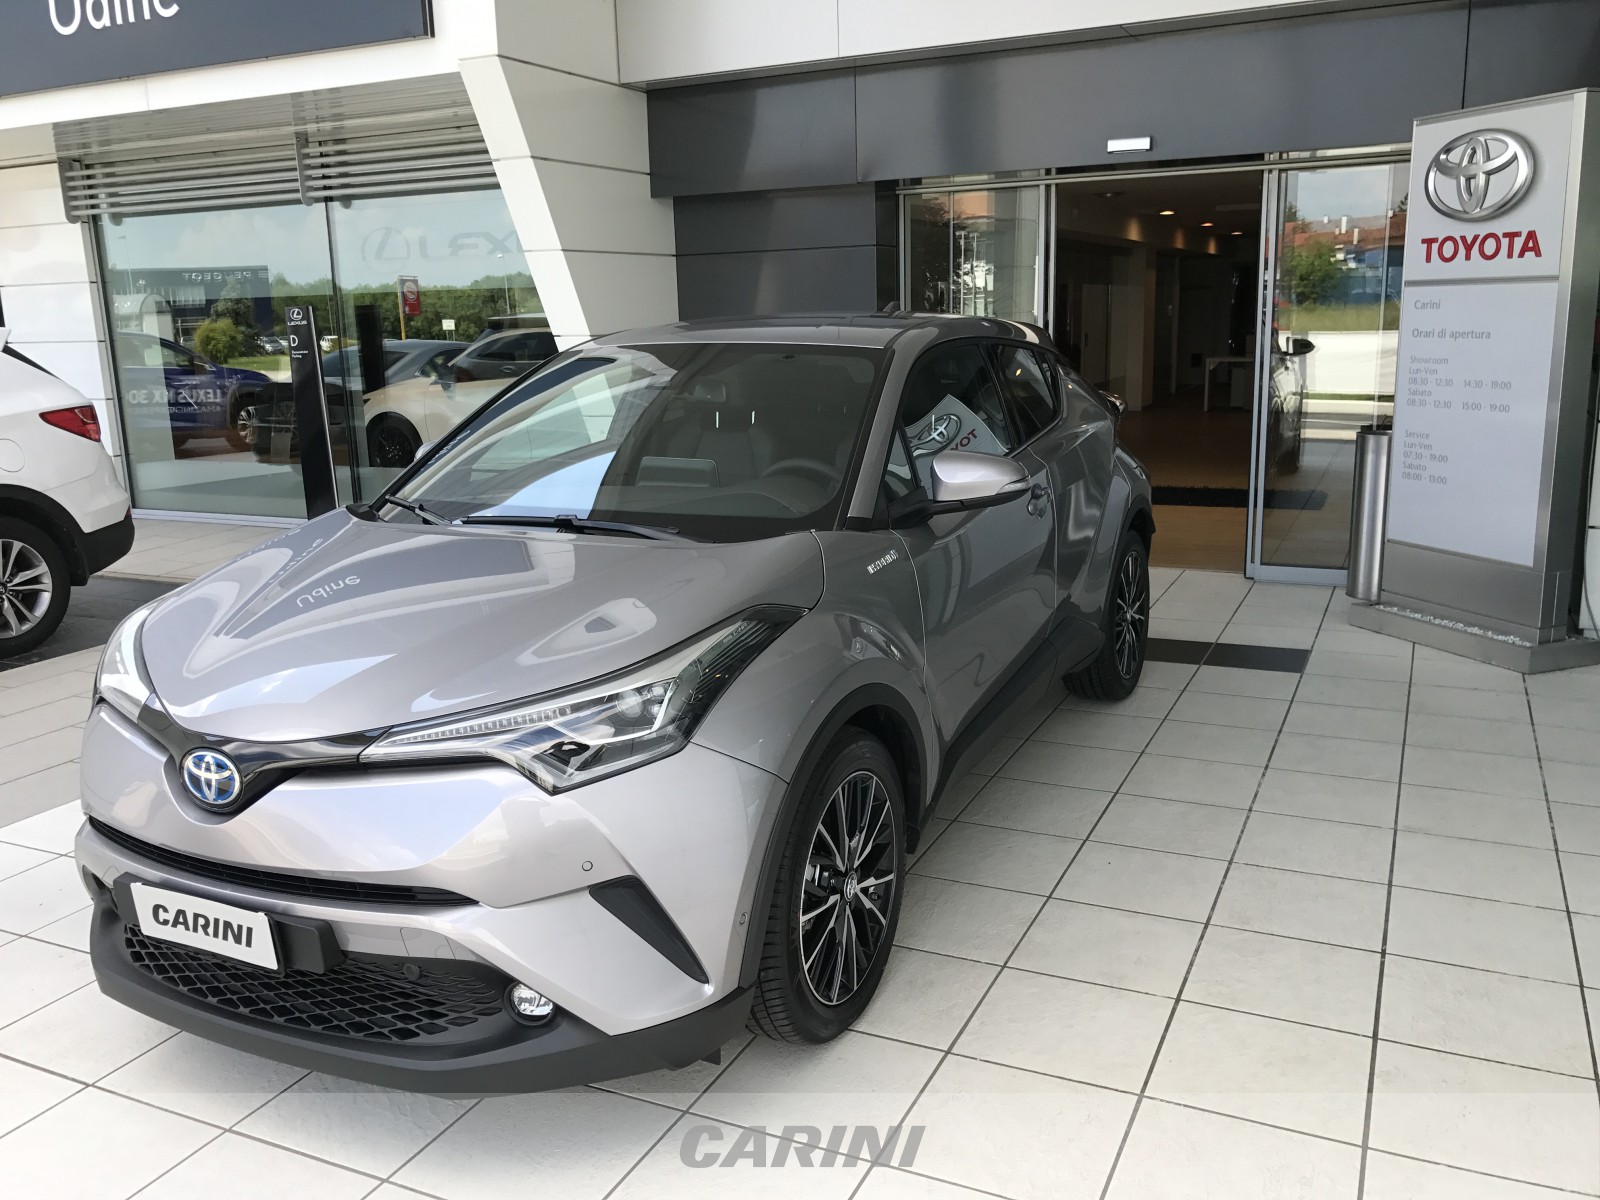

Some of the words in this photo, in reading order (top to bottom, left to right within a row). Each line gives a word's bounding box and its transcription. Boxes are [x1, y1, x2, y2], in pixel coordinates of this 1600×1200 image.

[1421, 230, 1542, 264] TOYOTA
[1414, 299, 1441, 310] Carini
[1412, 328, 1435, 339] Orari
[1437, 328, 1447, 339] di
[1449, 330, 1491, 341] apertura
[290, 335, 298, 347] D
[1409, 355, 1449, 365] Showroom
[1408, 366, 1438, 376] Lun-Ven
[1435, 378, 1454, 387] 12:30
[1464, 379, 1483, 389] 14:30
[1491, 380, 1512, 390] 19:00
[1407, 387, 1432, 397] Sabato
[1433, 399, 1452, 409] 12:30
[1462, 401, 1482, 411] 15:00
[1489, 403, 1511, 413] 19:00
[1405, 429, 1430, 440] Service
[1403, 440, 1433, 451] Lun-Ven
[1402, 461, 1427, 471] Sabato
[152, 903, 253, 949] CARINI
